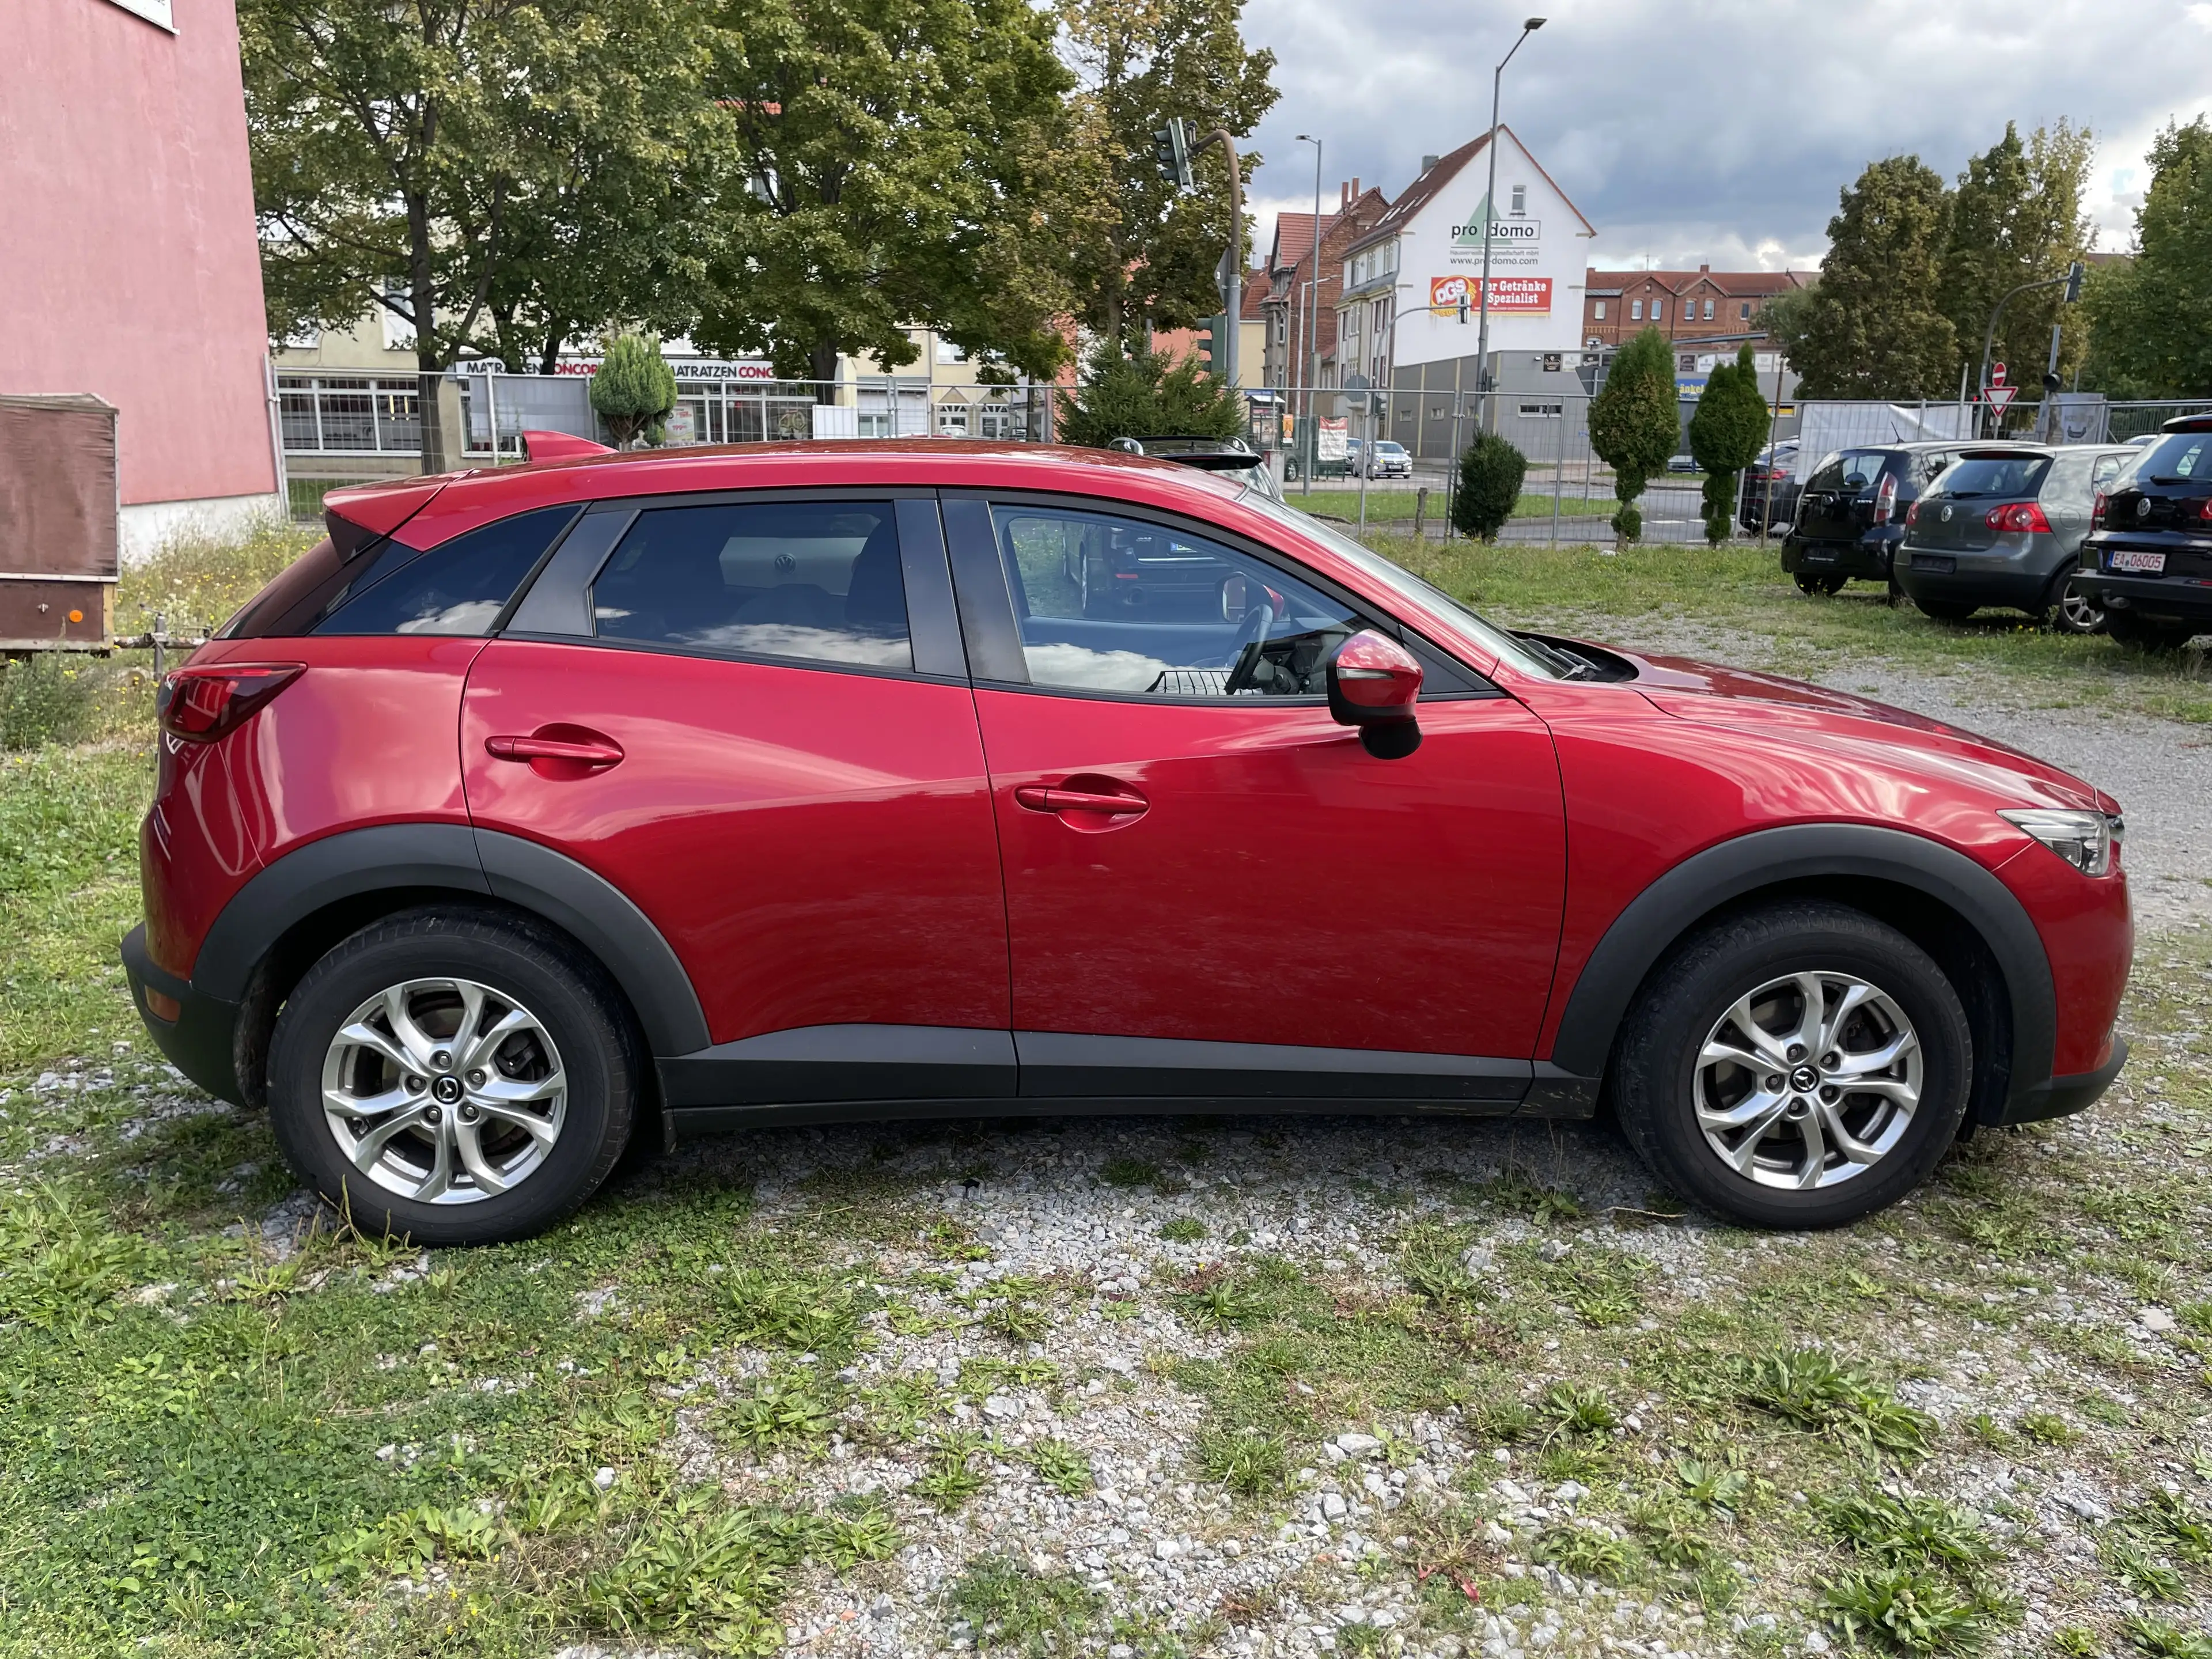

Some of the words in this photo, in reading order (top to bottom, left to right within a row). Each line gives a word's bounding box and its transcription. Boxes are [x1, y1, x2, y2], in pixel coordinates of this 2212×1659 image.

[1452, 225, 1478, 239] pro
[1490, 222, 1534, 237] domo
[1450, 255, 1538, 266] www.pr-domo.com
[1435, 279, 1466, 304] DGS
[1499, 279, 1547, 292] Getränke
[1487, 292, 1539, 306] Spezialist
[467, 362, 541, 374] MATREN
[554, 363, 597, 375] ONCOR
[738, 366, 775, 378] CONC
[2113, 552, 2125, 566] EA
[2130, 554, 2162, 569] 06005
